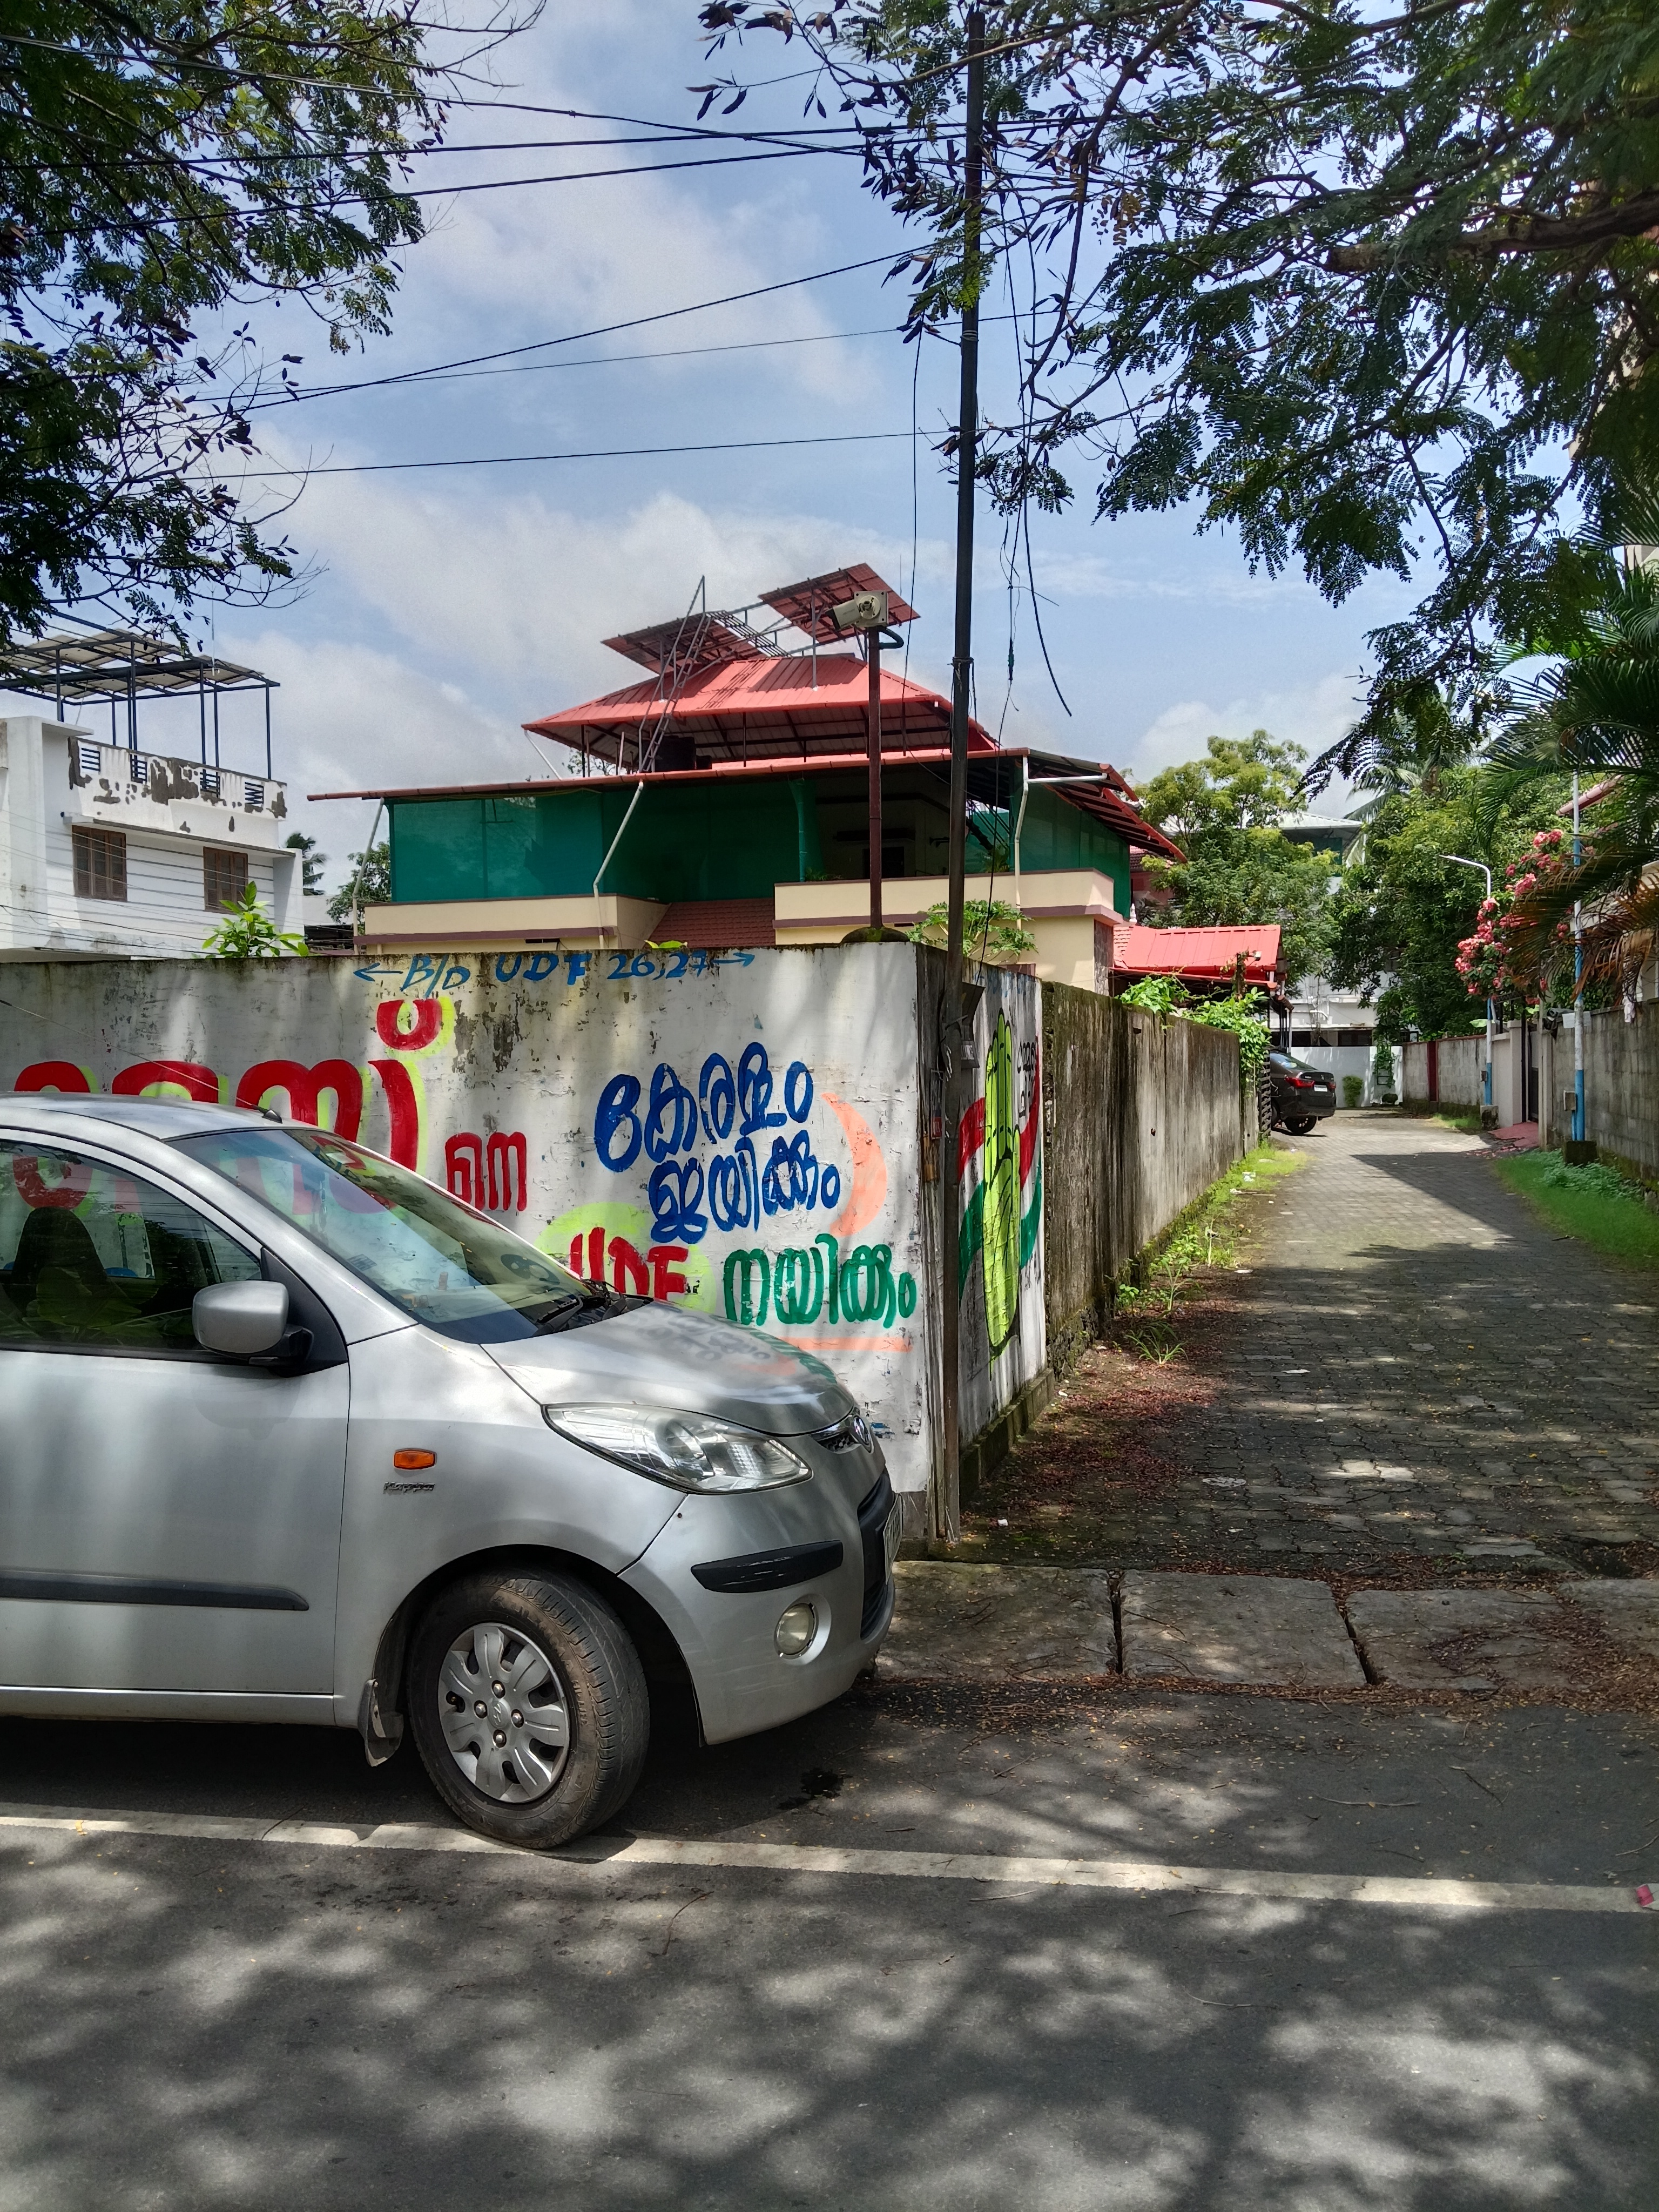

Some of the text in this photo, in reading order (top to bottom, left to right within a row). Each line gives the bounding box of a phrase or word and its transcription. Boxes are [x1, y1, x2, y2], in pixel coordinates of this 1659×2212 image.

[495, 953, 591, 986] UDF
[607, 951, 707, 981] 26,27
[594, 1042, 814, 1173] കേരളം
[383, 1481, 436, 1494] Kappa
